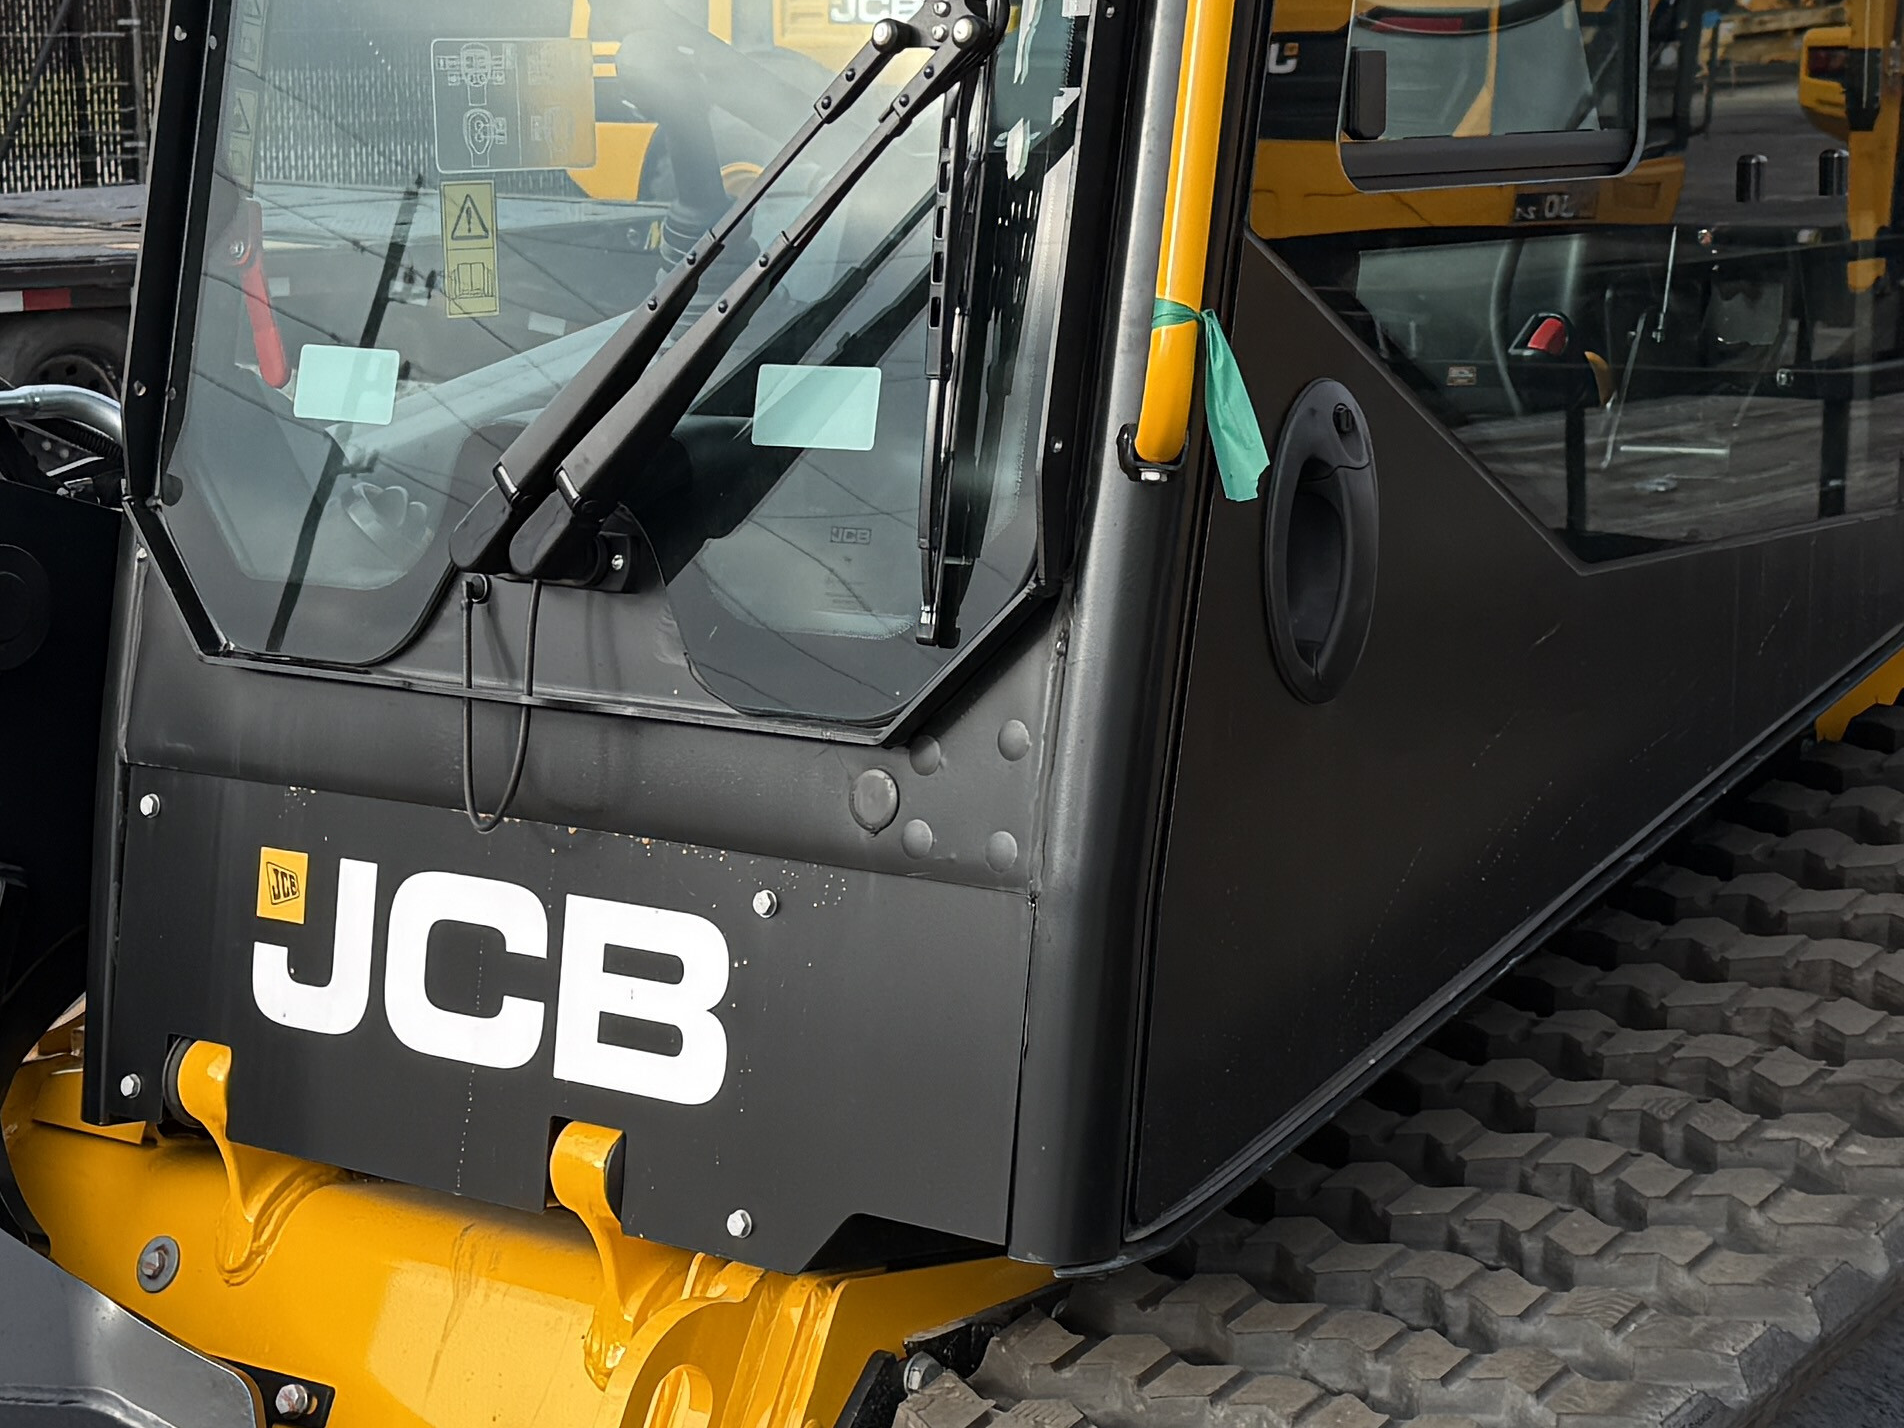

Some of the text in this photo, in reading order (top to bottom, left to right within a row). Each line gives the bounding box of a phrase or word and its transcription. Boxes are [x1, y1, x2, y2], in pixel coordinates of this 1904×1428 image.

[832, 528, 871, 544] JCB
[272, 868, 298, 900] JCB
[253, 858, 730, 1105] JCB
